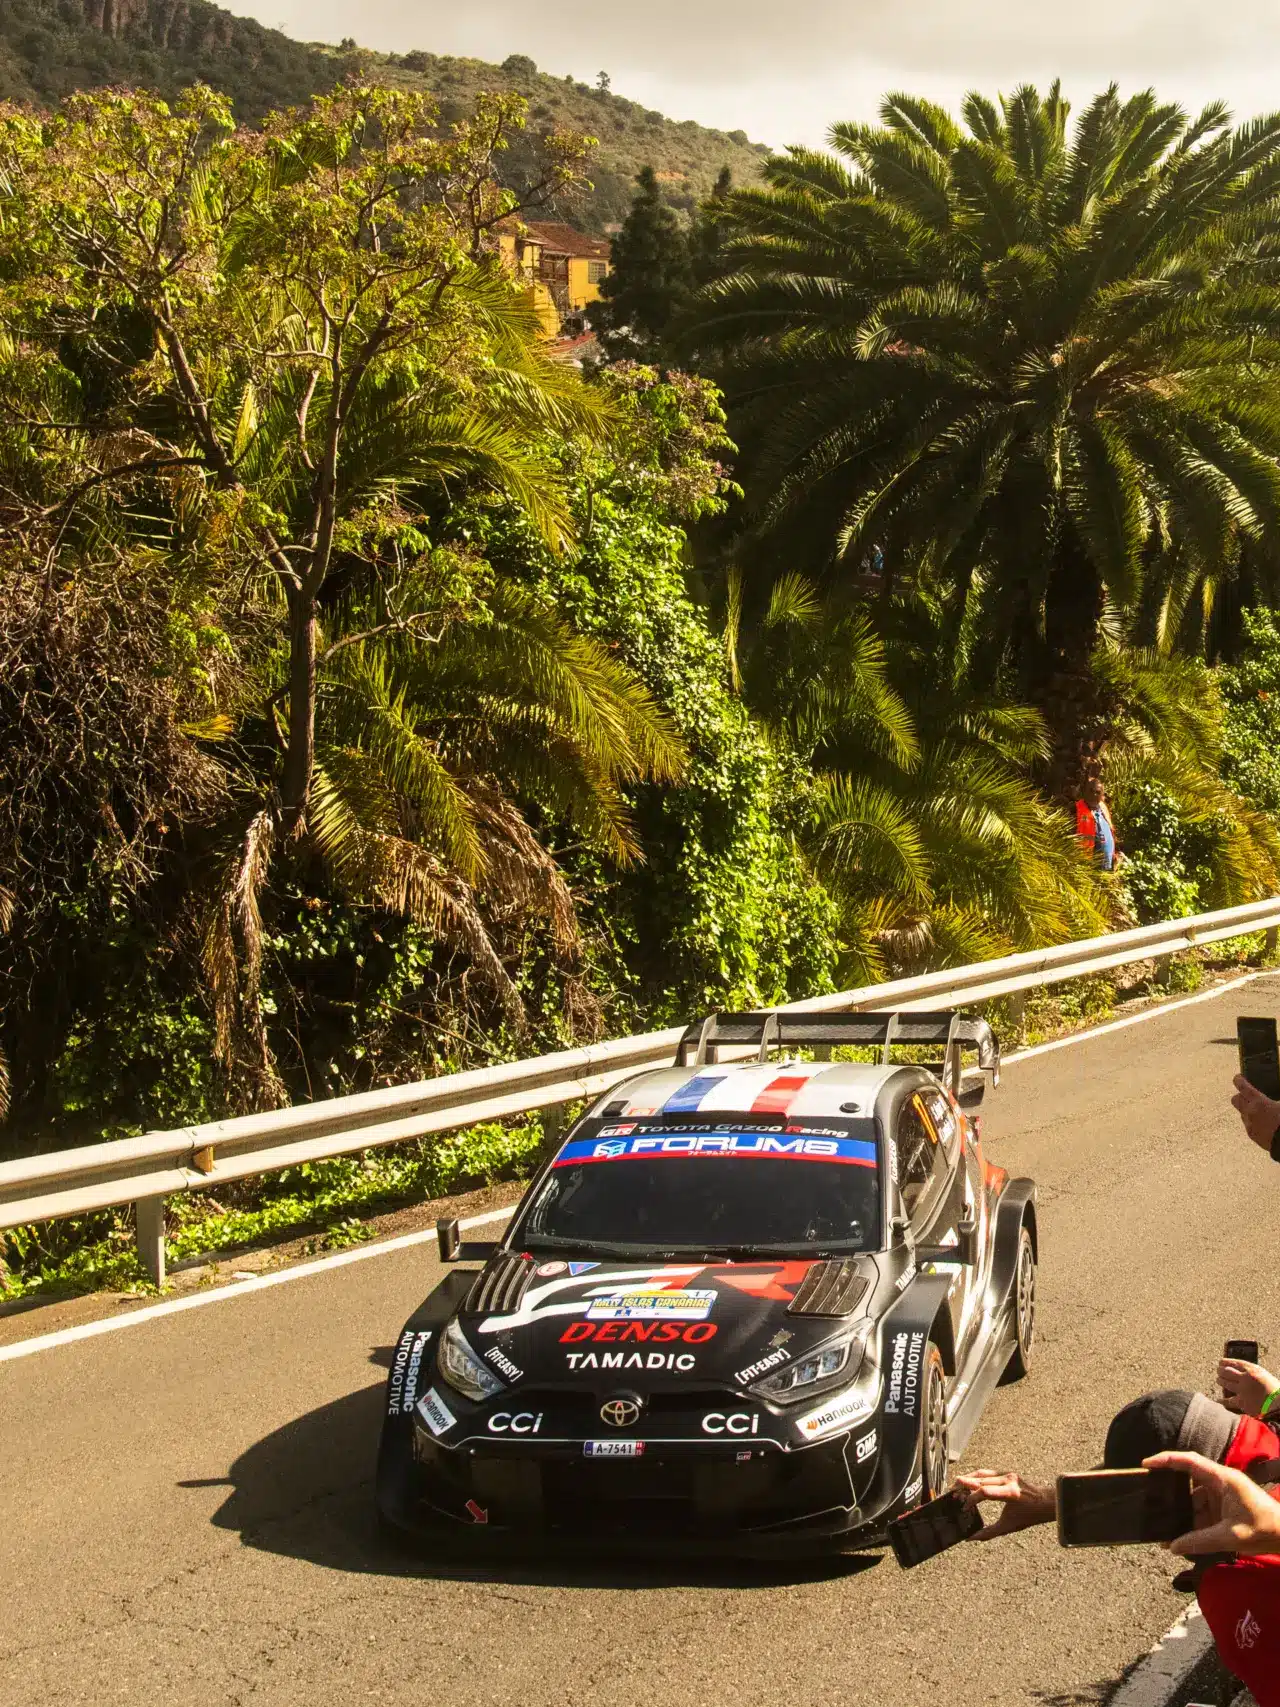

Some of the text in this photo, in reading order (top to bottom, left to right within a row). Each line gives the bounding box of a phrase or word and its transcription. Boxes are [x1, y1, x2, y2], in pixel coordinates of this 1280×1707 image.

[640, 1124, 711, 1134] TOYOTA
[715, 1123, 783, 1133] GAZOO
[630, 1136, 838, 1156] FORUM8
[621, 1298, 655, 1308] ISLAS
[655, 1298, 711, 1308] CANARIAS
[559, 1321, 719, 1344] DENSO
[403, 1331, 432, 1412] Panasonic
[565, 1352, 697, 1371] TAMADIC
[884, 1332, 908, 1414] Panasonic
[388, 1331, 415, 1416] AUTOMOTIVE
[903, 1331, 924, 1417] AUTOMOTIVE
[596, 1443, 633, 1454] A-7541
[856, 1433, 877, 1459] OMP
